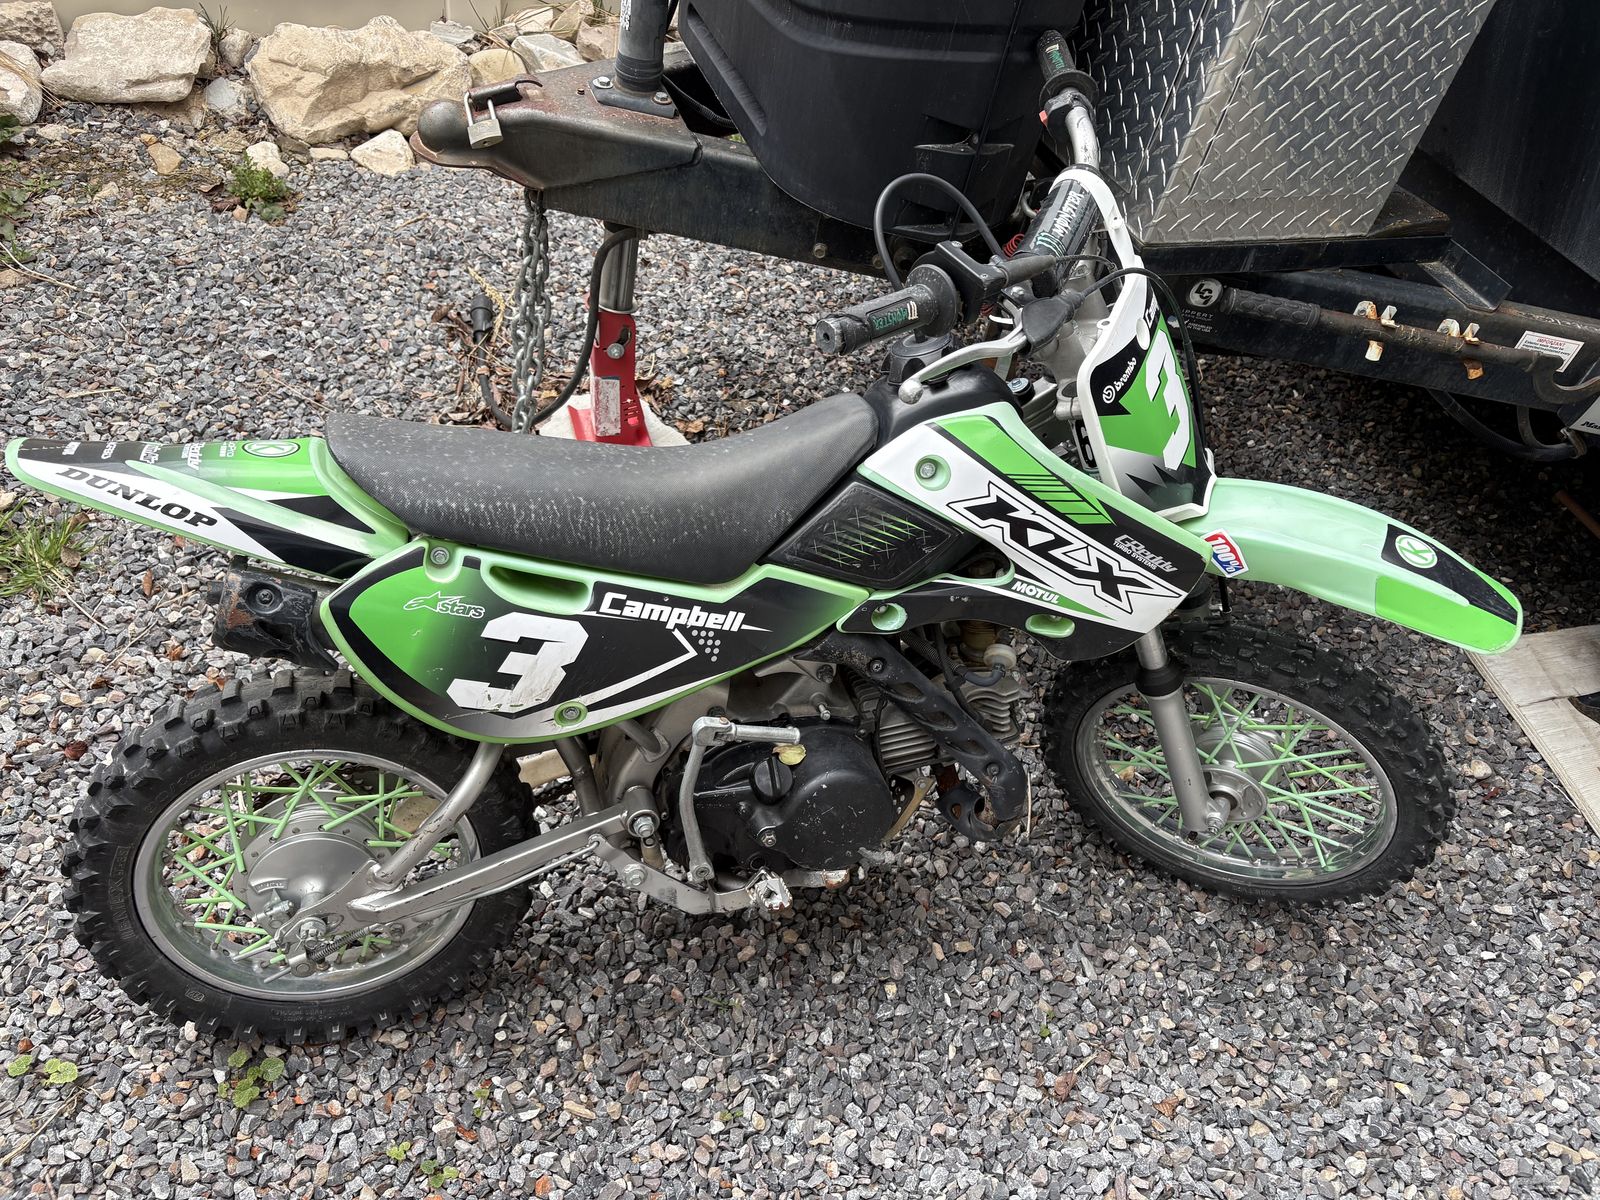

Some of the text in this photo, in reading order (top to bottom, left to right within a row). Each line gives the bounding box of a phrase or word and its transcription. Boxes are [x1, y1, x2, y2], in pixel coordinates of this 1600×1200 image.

[1052, 190, 1085, 238] MONSTER
[1113, 357, 1137, 392] brembo
[1146, 329, 1191, 471] 3
[56, 467, 218, 527] DUNLOP
[950, 484, 1177, 612] KLX
[1113, 540, 1158, 570] TURBO SYSTEMS
[1115, 534, 1178, 572] GReddy
[1211, 536, 1243, 573] 100%
[599, 591, 746, 632] Campbell
[1011, 580, 1061, 605] MOTUL
[446, 612, 589, 714] 3
